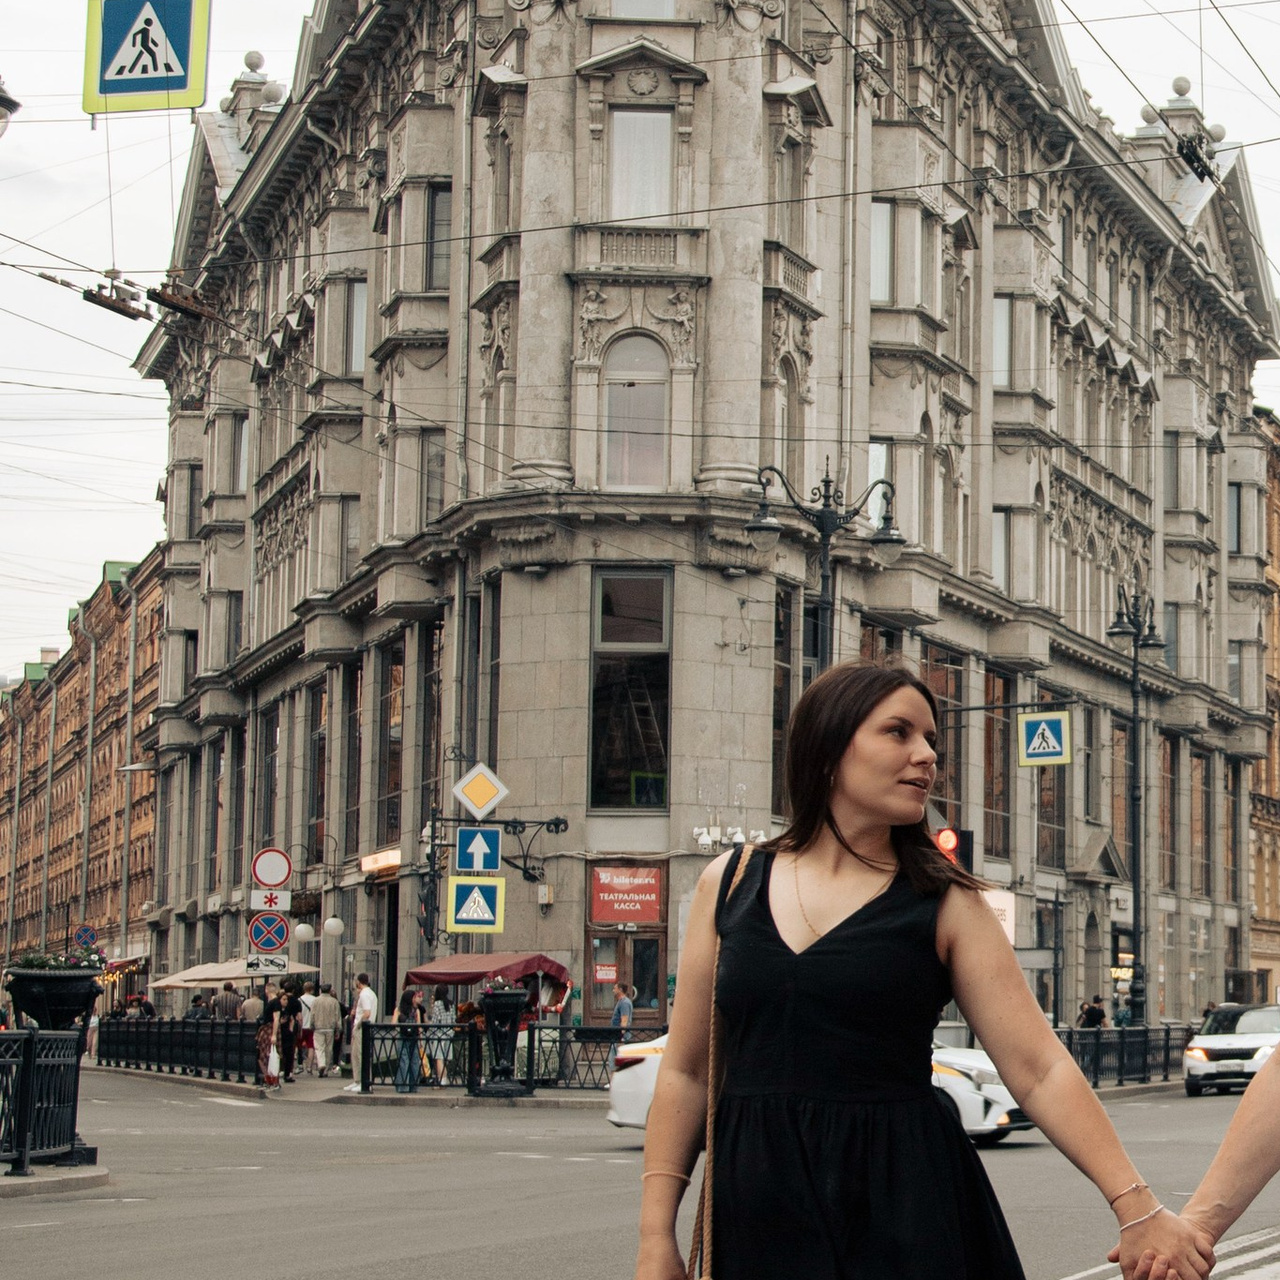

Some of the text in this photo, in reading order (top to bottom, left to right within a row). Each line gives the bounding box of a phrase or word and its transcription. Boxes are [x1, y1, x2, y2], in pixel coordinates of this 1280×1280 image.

[613, 876, 656, 884] bileter.ru
[599, 893, 656, 901] ТЕАТРАЛЬНАЯ
[614, 902, 641, 910] КАССА
